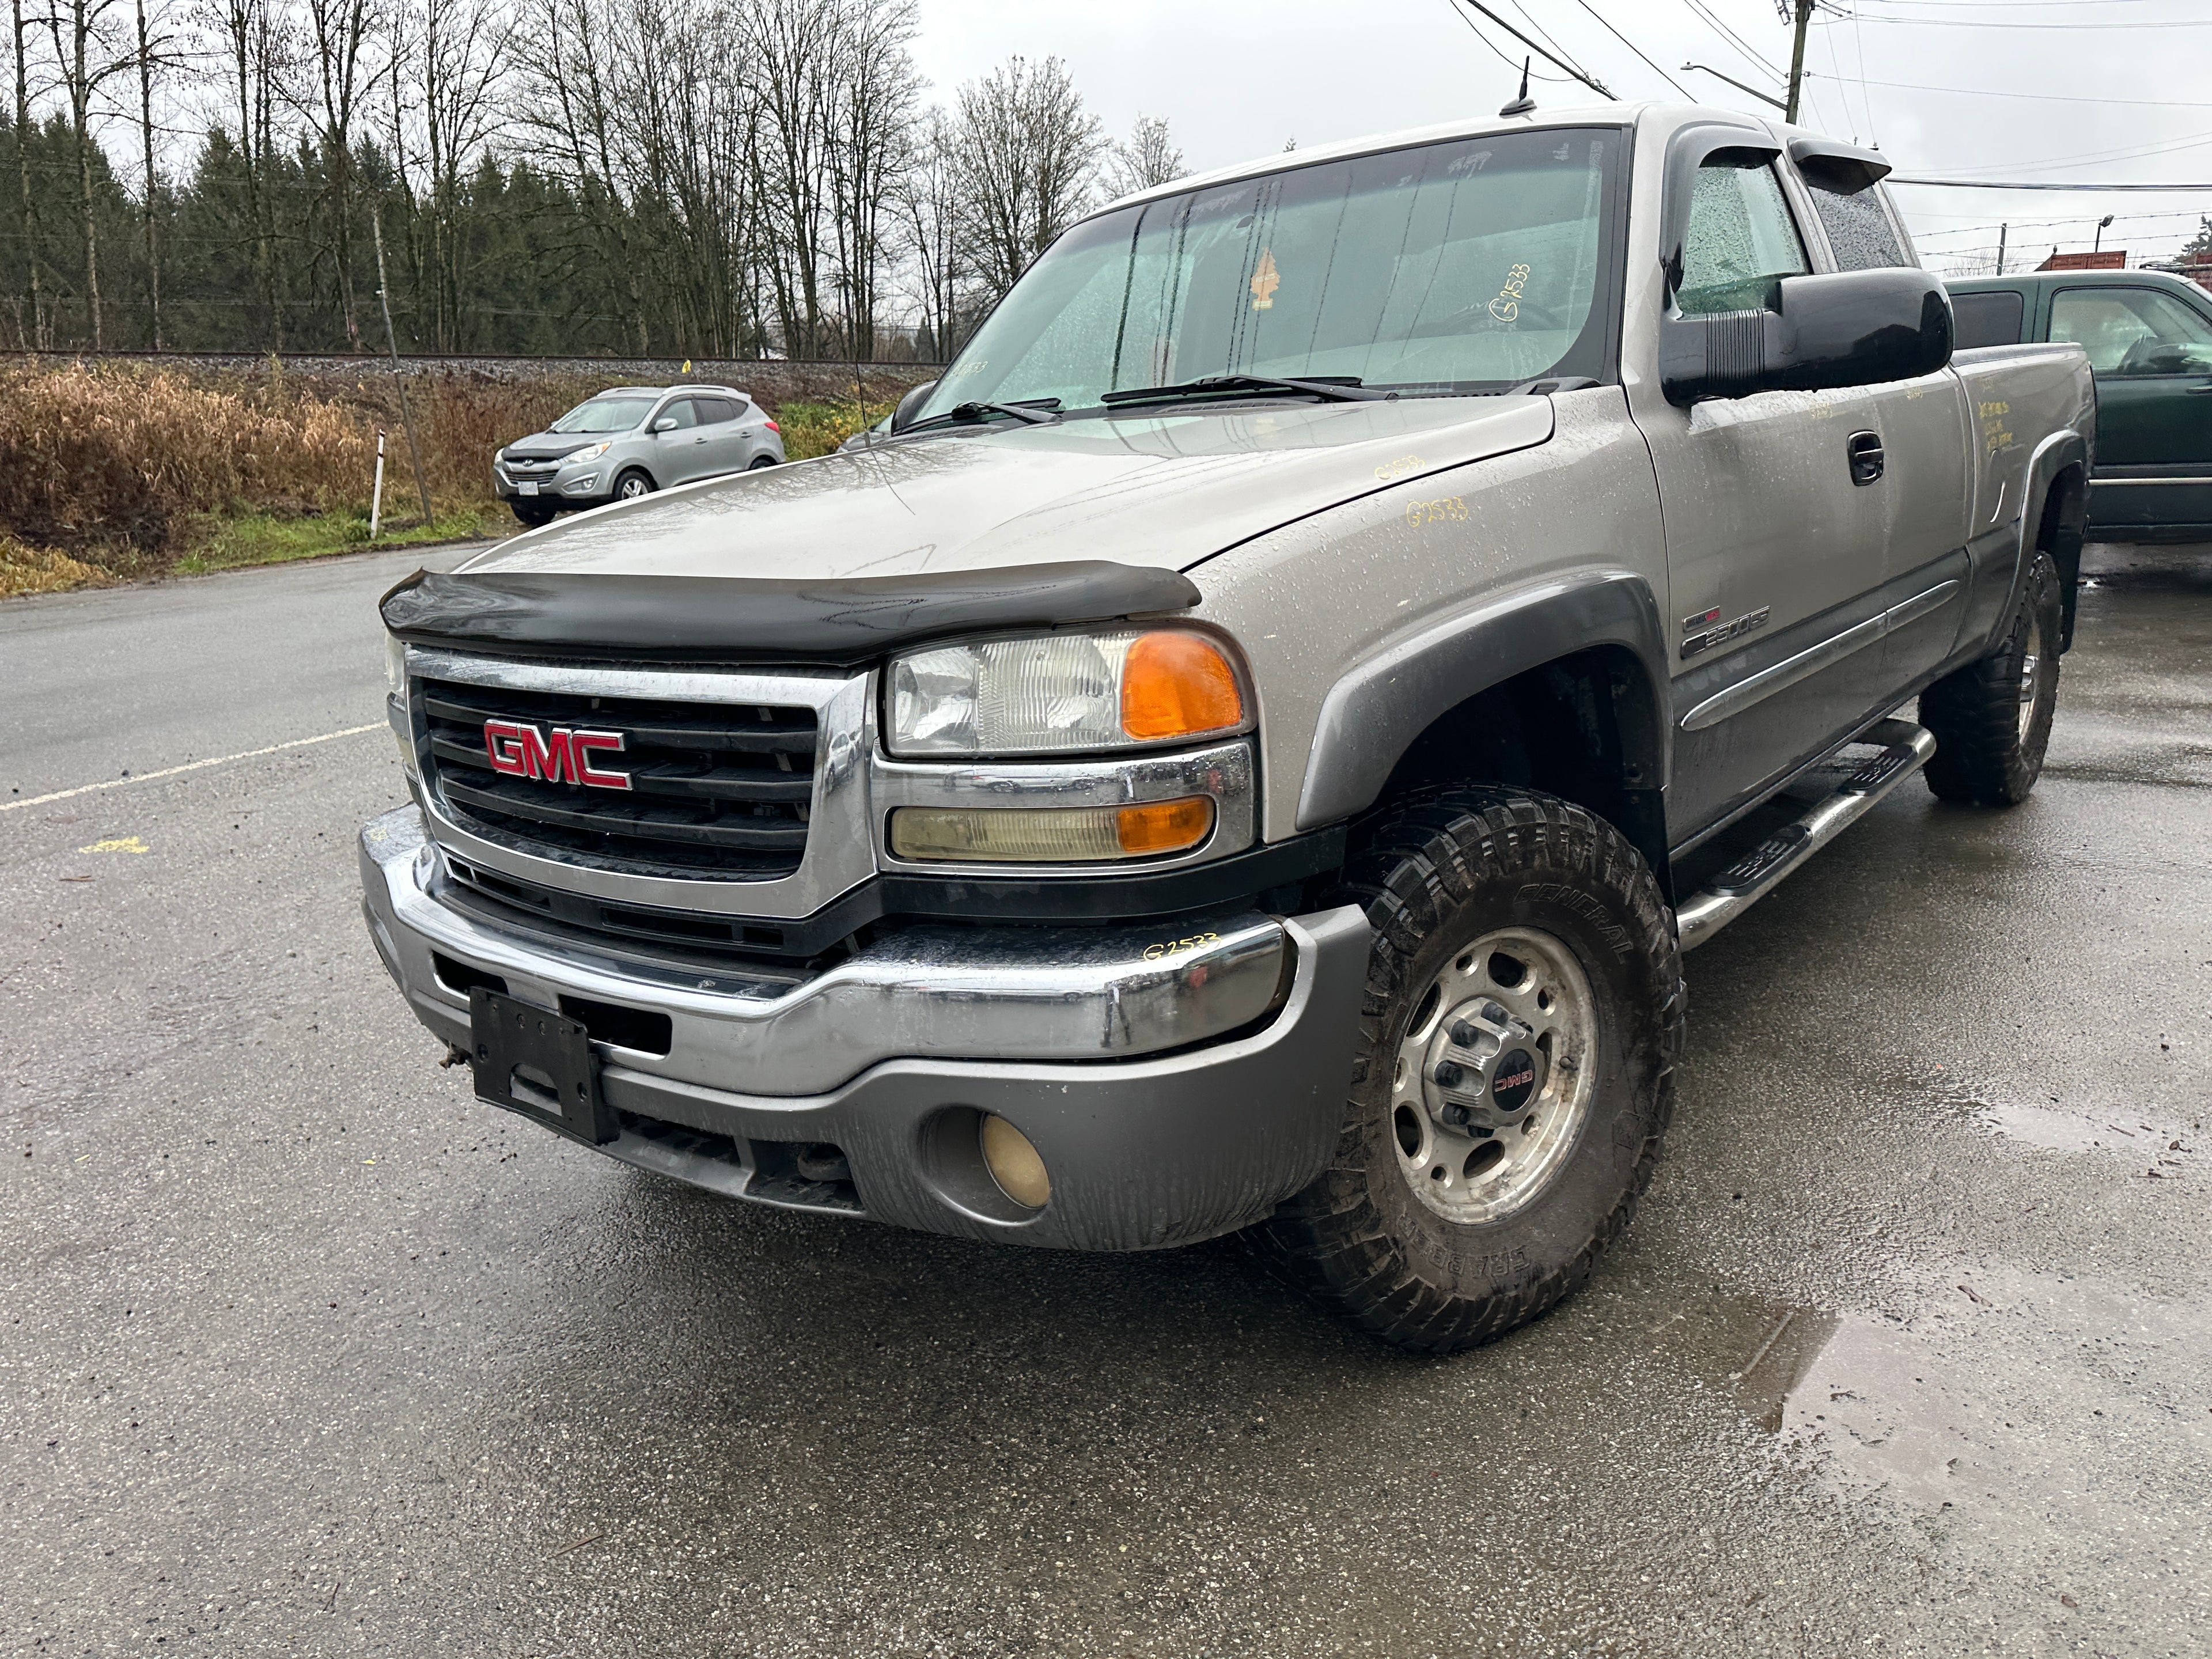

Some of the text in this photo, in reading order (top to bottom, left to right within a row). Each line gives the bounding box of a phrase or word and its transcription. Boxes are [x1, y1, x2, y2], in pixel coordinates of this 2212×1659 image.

[1406, 496, 1468, 527] G2533
[484, 719, 632, 791] GMC
[1513, 884, 1634, 965] GENERAL
[1143, 933, 1222, 961] G2533
[1495, 1070, 1533, 1092] GMC
